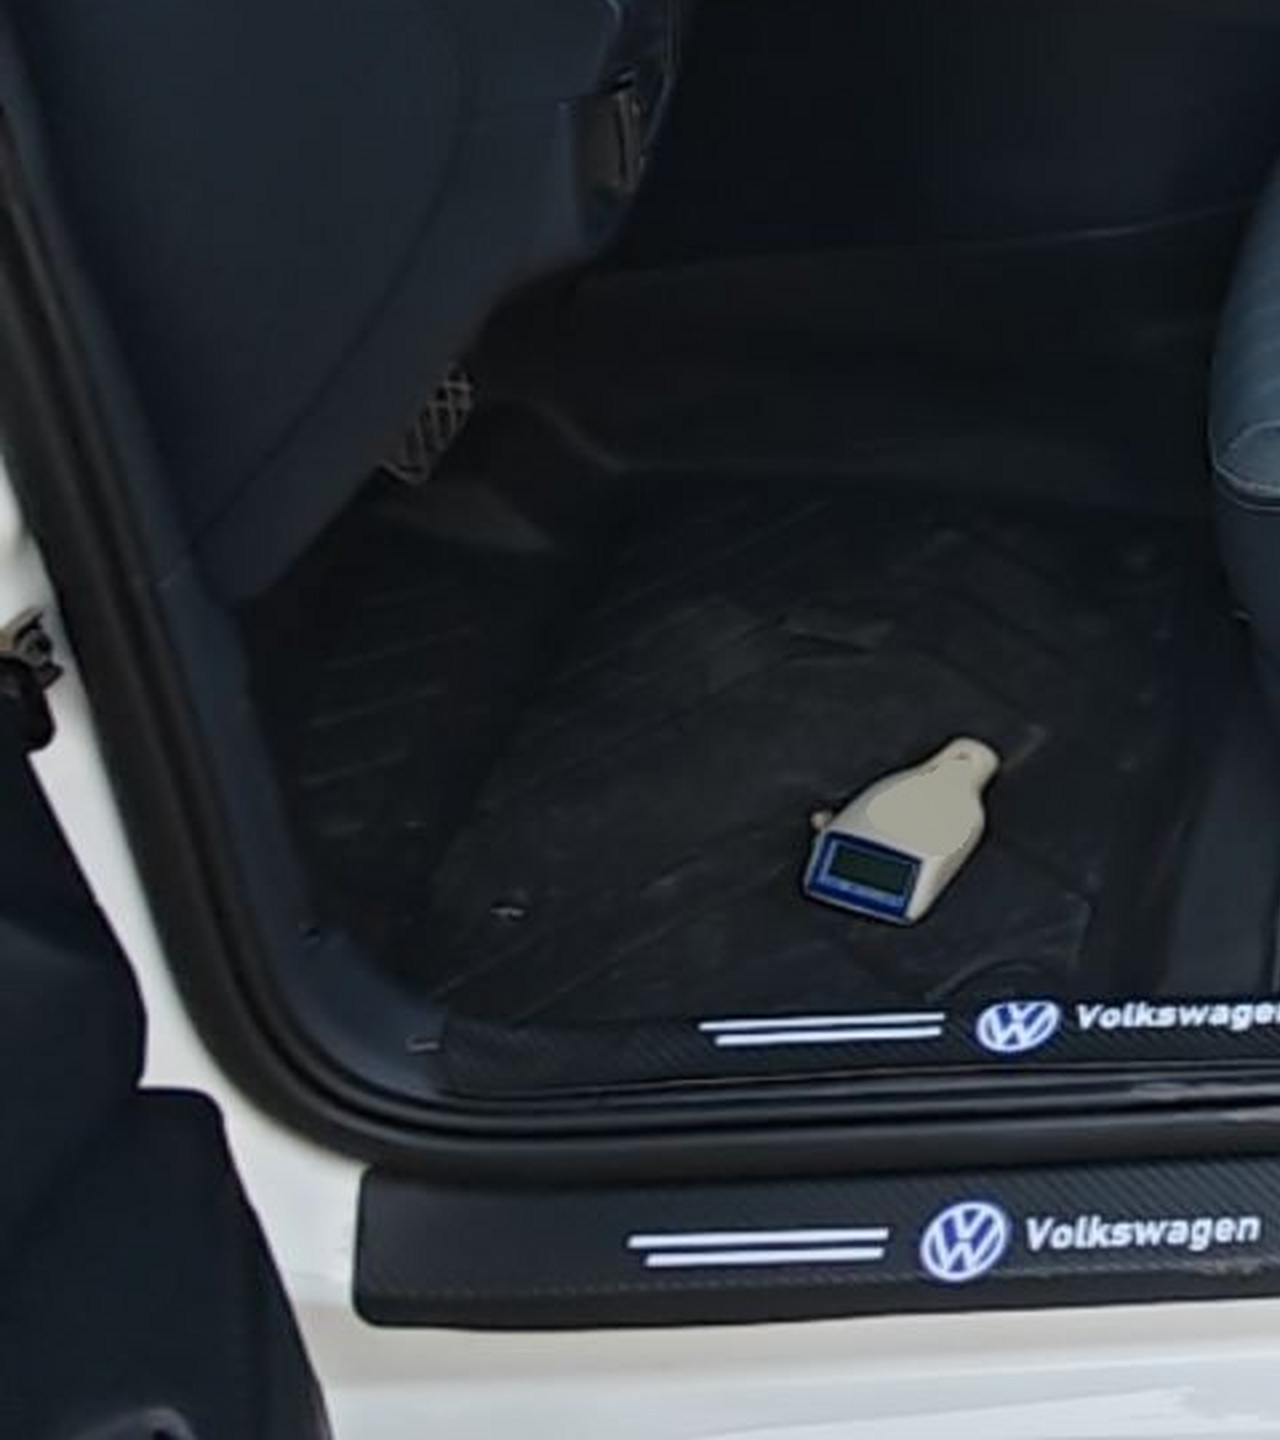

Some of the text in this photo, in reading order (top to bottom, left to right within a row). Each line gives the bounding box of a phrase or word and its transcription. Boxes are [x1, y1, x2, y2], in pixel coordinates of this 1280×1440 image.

[975, 1000, 1061, 1053] VW
[920, 1201, 1262, 1282] VW Volkswagen
